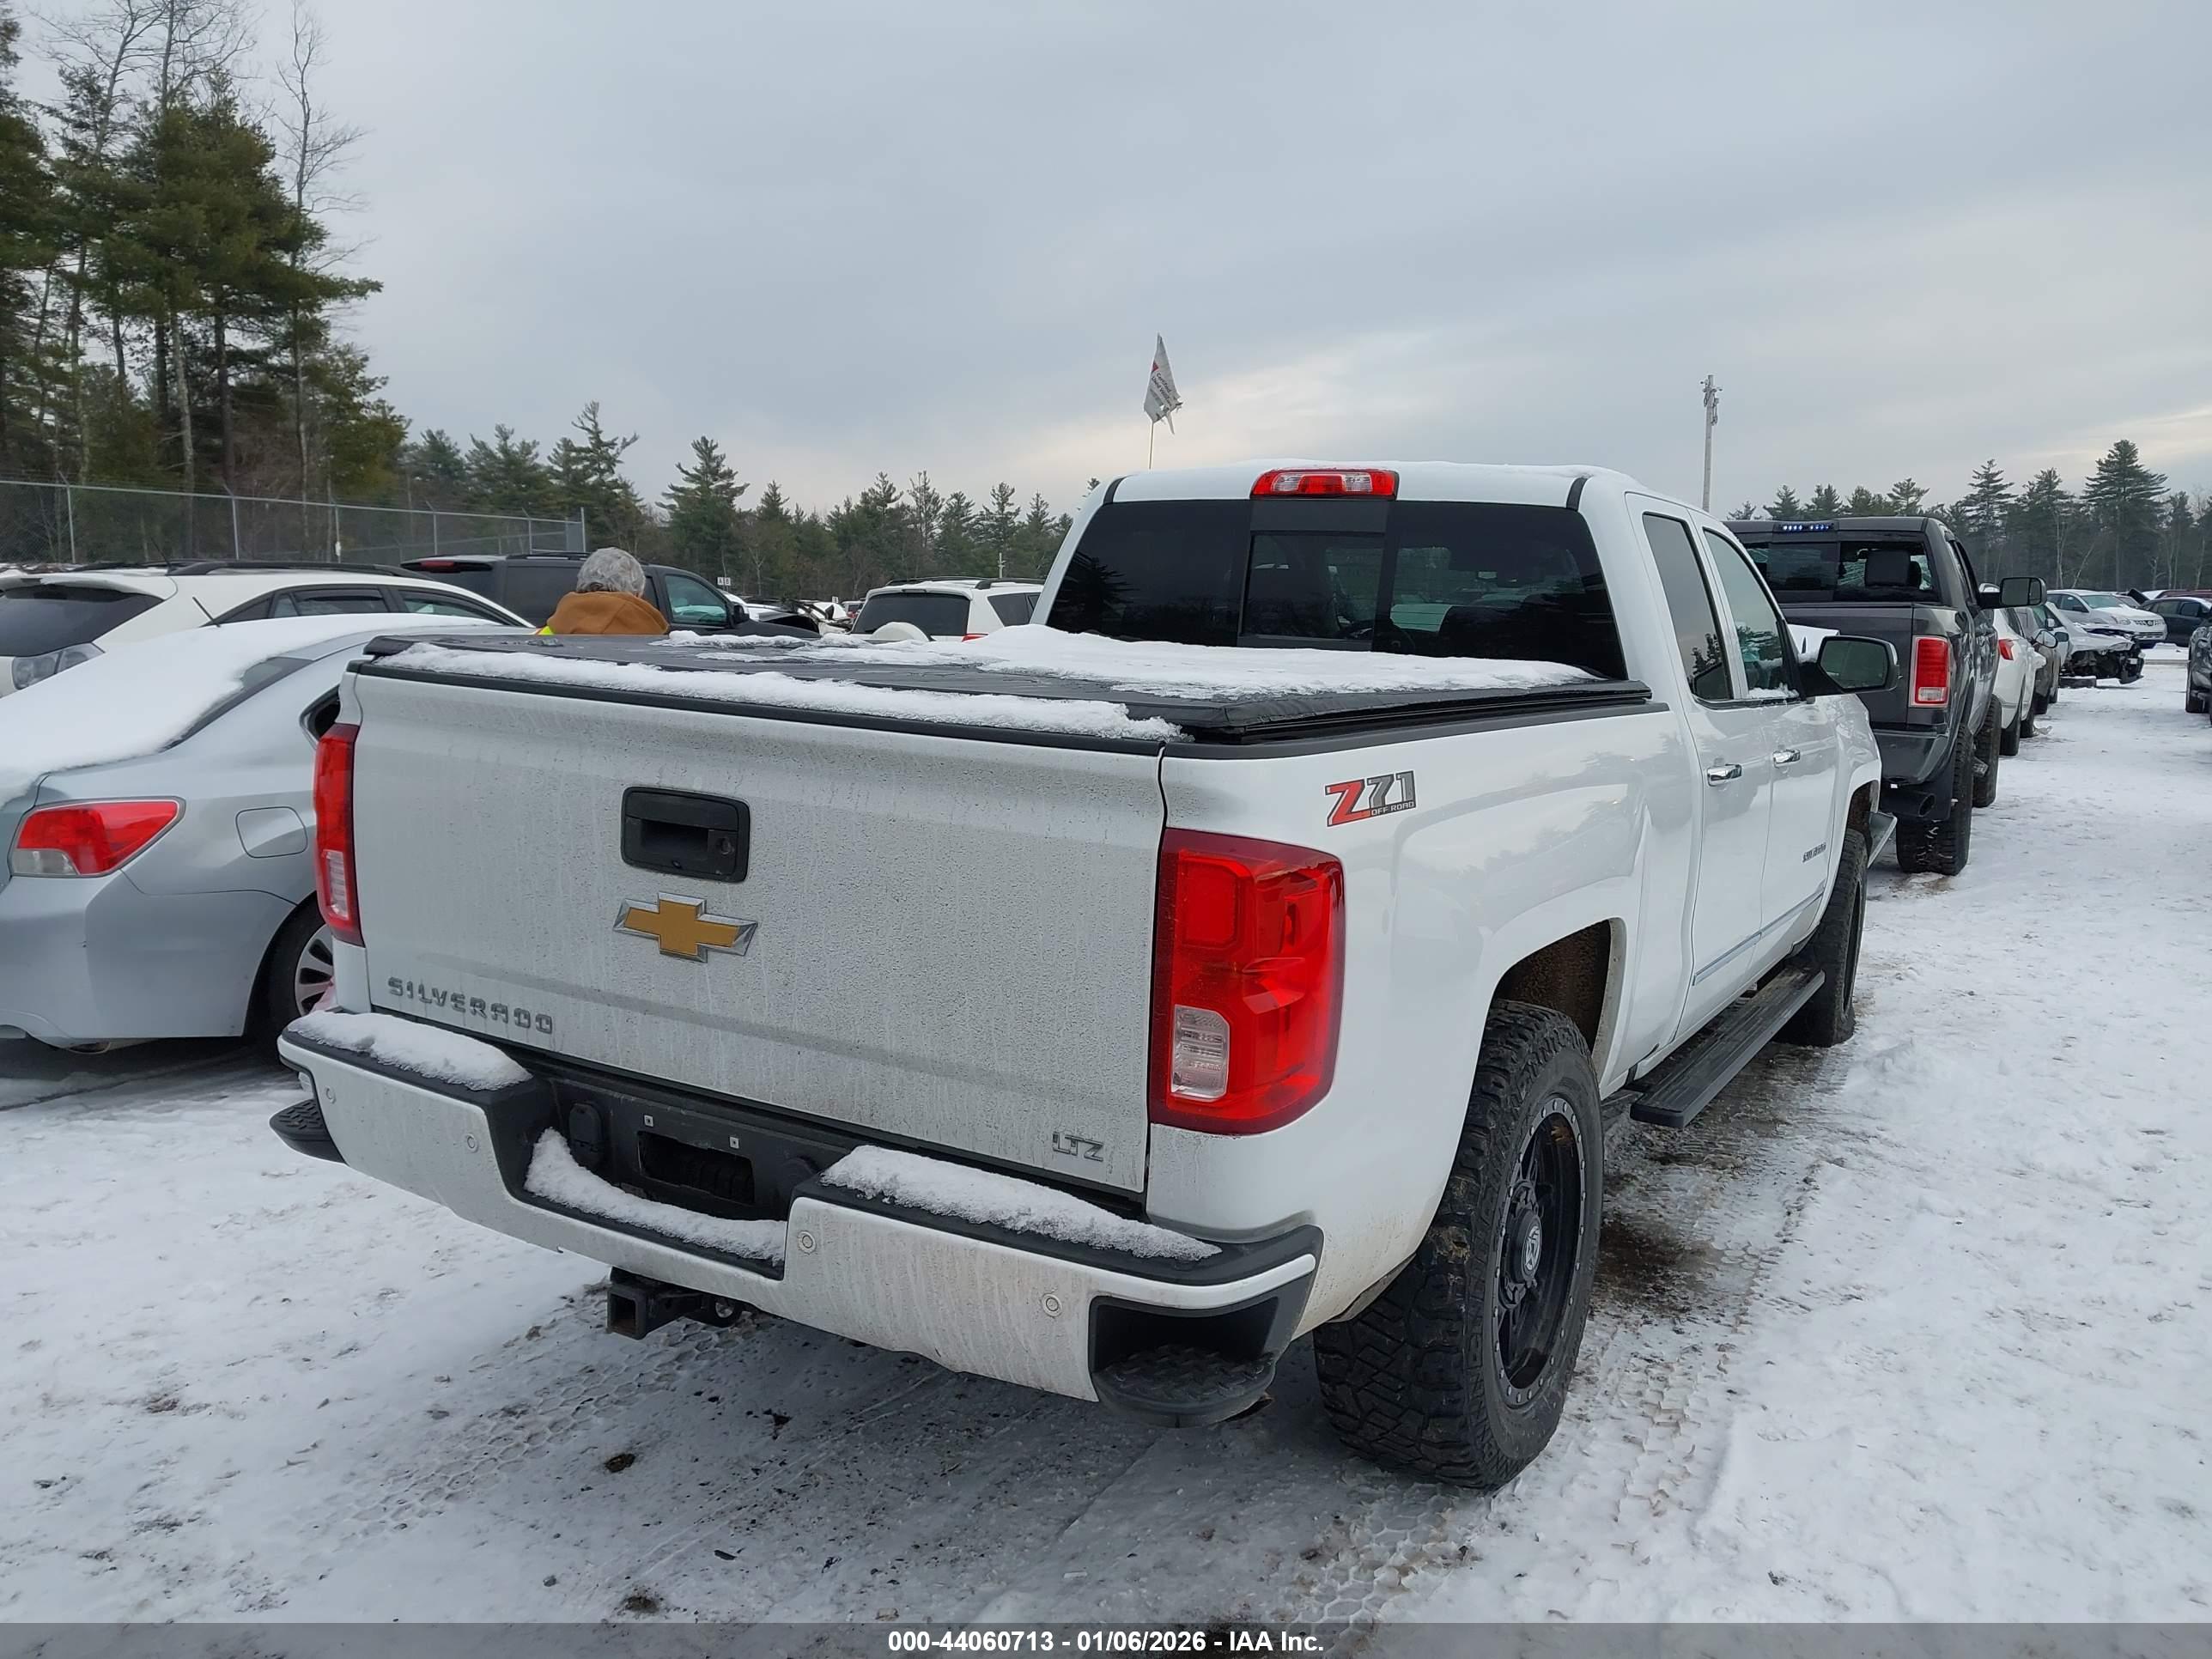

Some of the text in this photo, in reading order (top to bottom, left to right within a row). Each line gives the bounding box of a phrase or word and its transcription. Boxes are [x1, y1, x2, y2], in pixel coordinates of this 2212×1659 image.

[1324, 770, 1415, 827] Z71
[1370, 800, 1415, 817] OFF ROAD
[388, 976, 554, 1035] SILVERADO
[1052, 1131, 1104, 1163] LTZ
